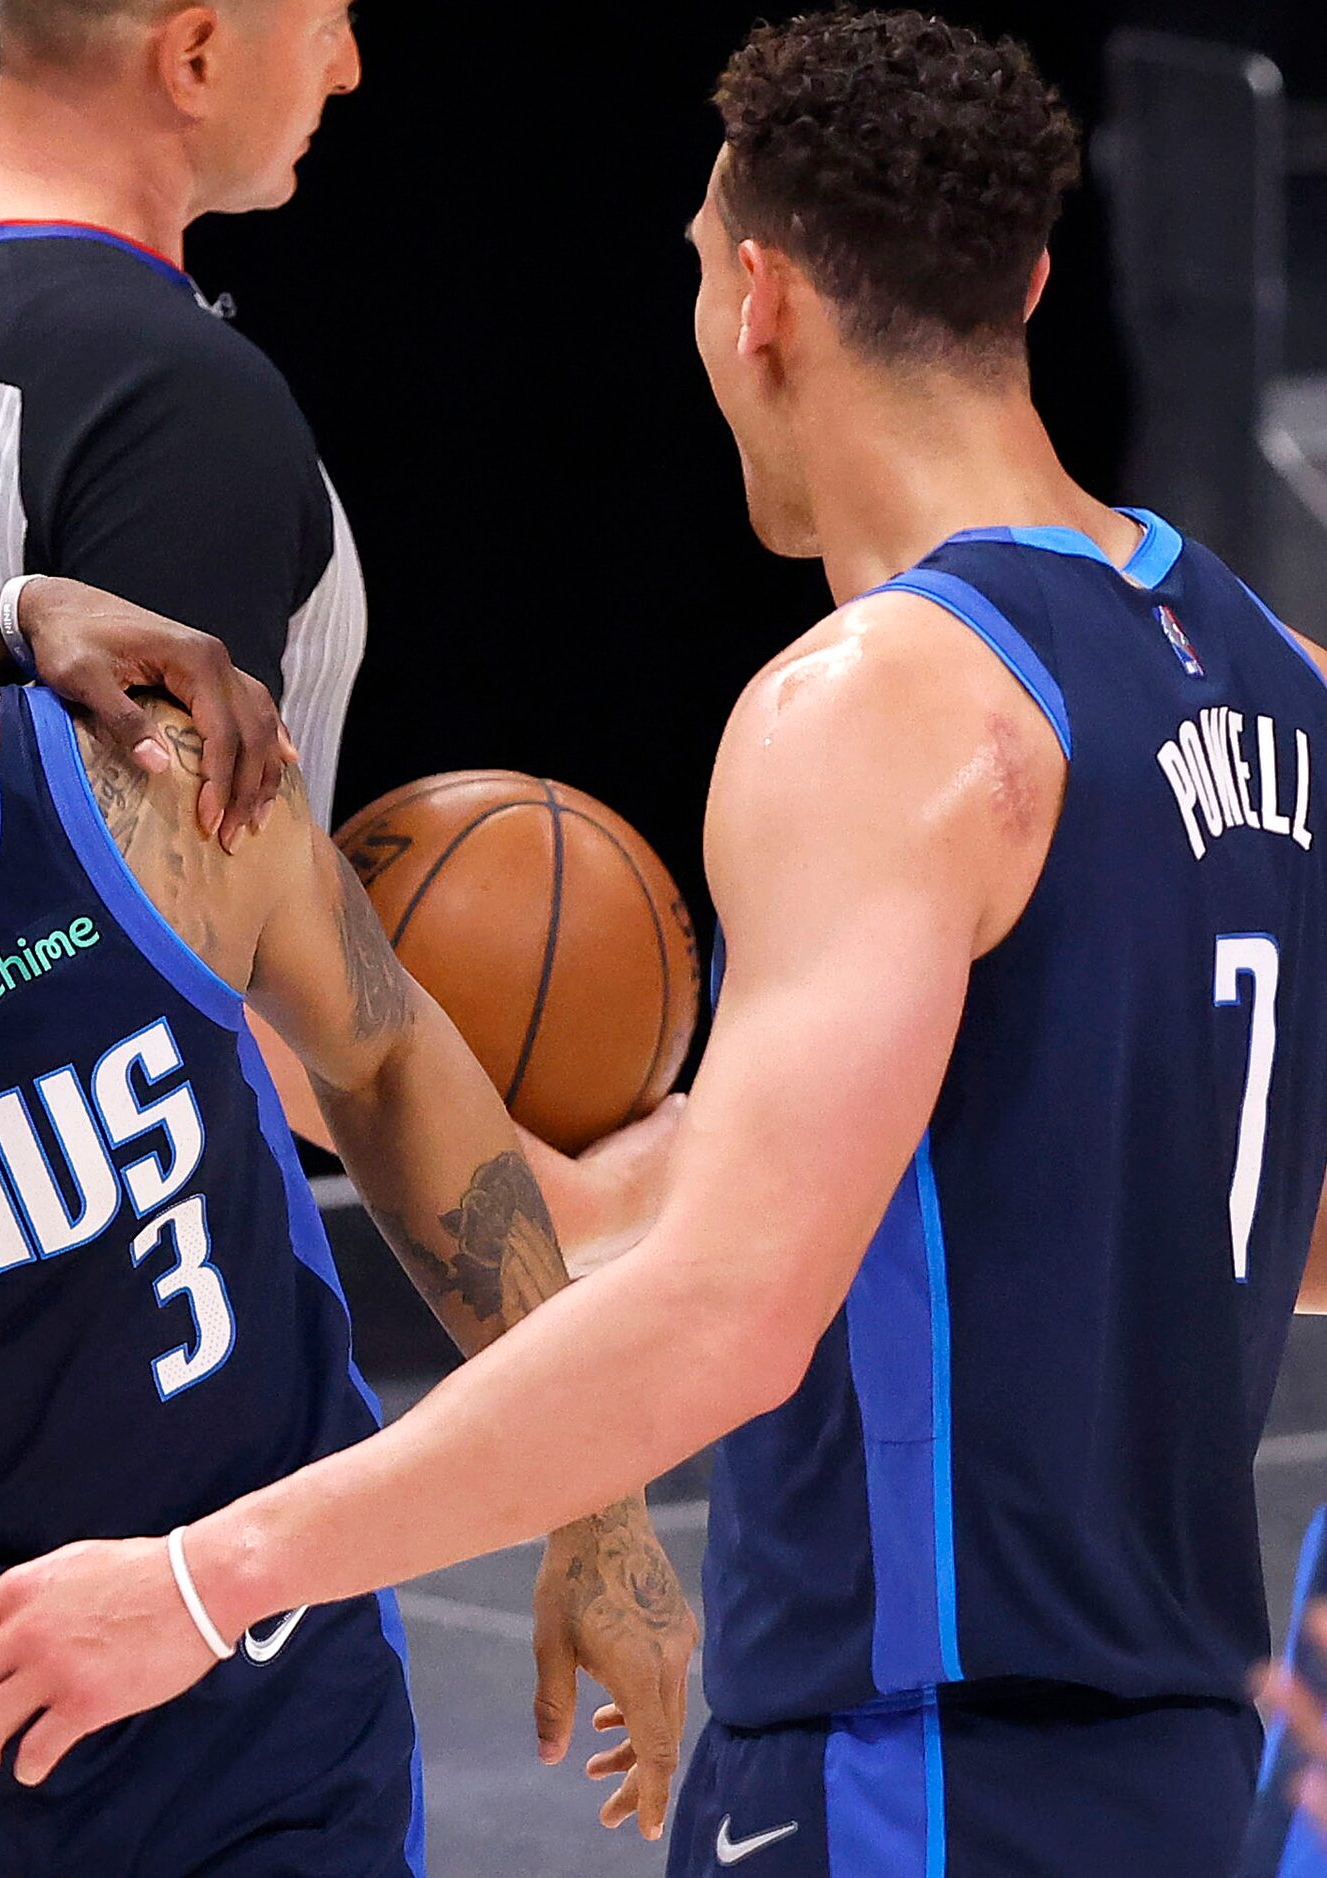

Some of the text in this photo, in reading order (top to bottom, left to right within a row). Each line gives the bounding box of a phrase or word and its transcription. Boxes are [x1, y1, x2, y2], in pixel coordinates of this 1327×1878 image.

[1156, 706, 1312, 861] POWELL
[1213, 932, 1281, 1284] 7
[130, 1193, 236, 1402] 3
